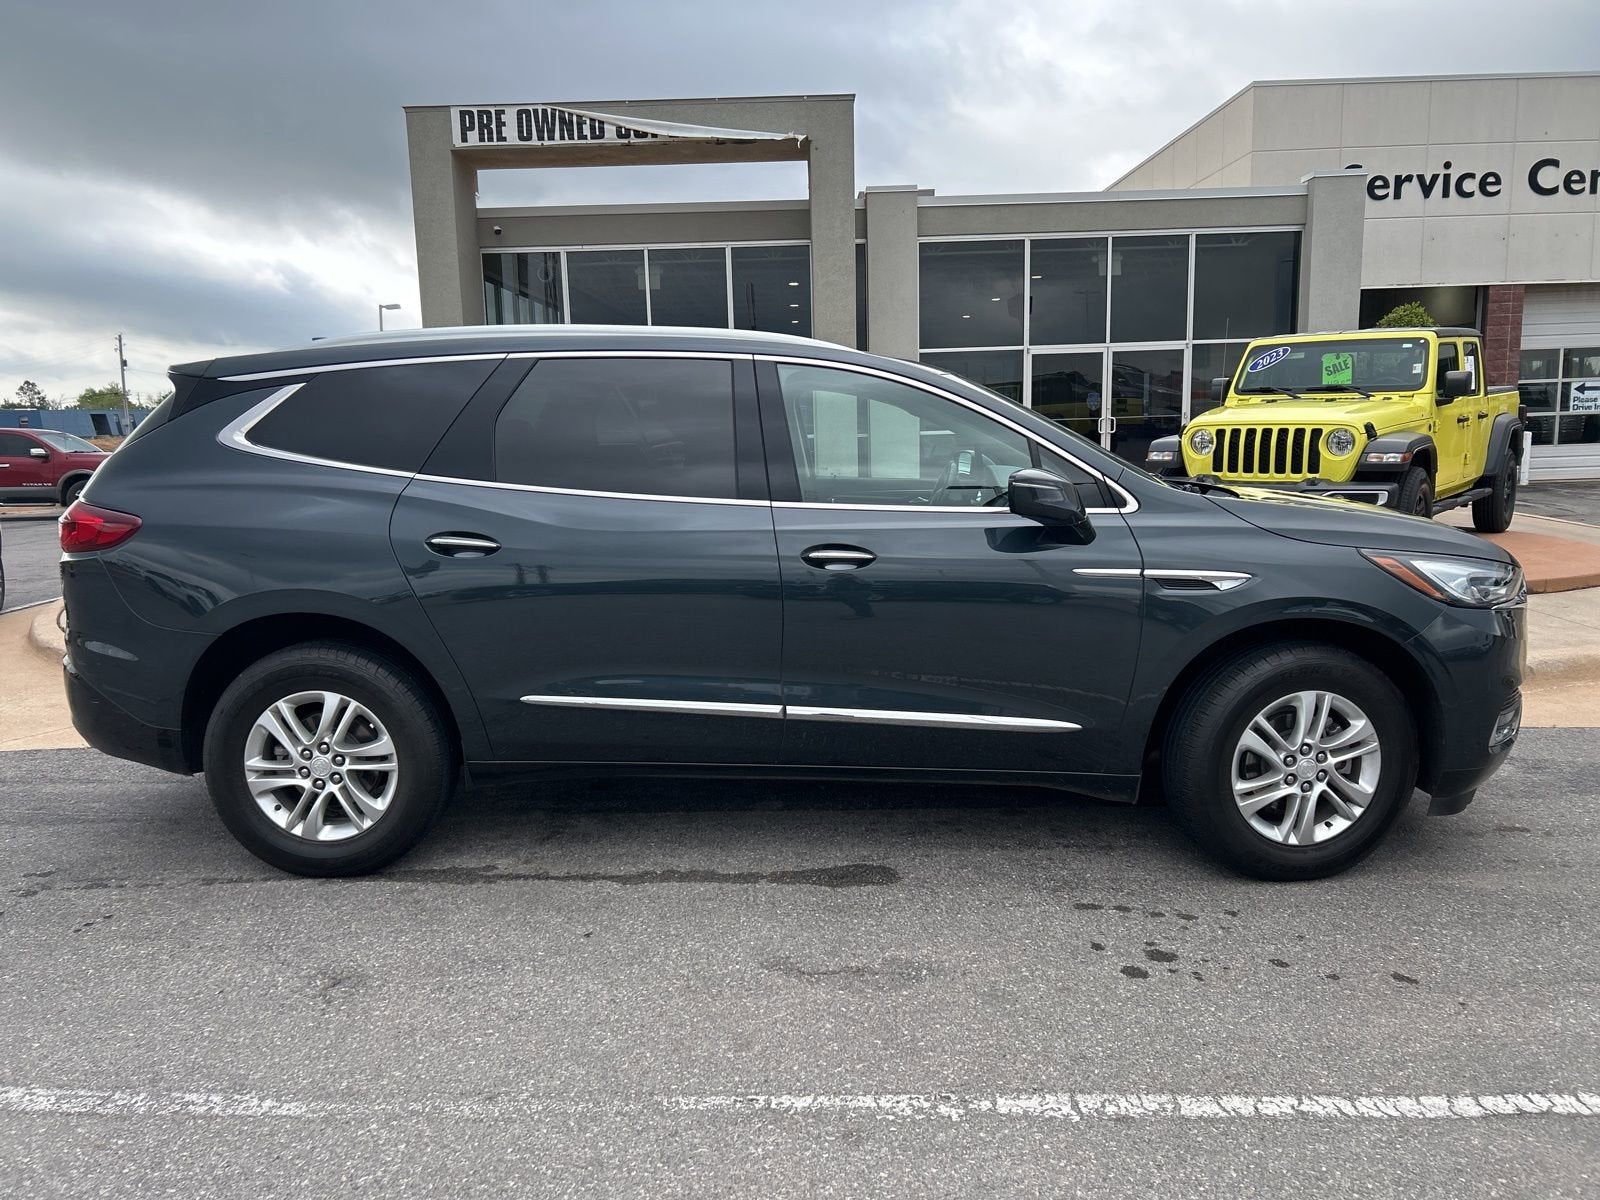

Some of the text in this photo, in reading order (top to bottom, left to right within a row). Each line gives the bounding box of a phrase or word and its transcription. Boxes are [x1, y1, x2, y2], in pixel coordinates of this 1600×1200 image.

[459, 109, 507, 143] PRE
[516, 107, 605, 141] OWNED
[1344, 160, 1502, 200] ervice
[1256, 348, 1284, 370] 2023
[1324, 359, 1351, 376] SALE
[1572, 403, 1593, 411] Drive
